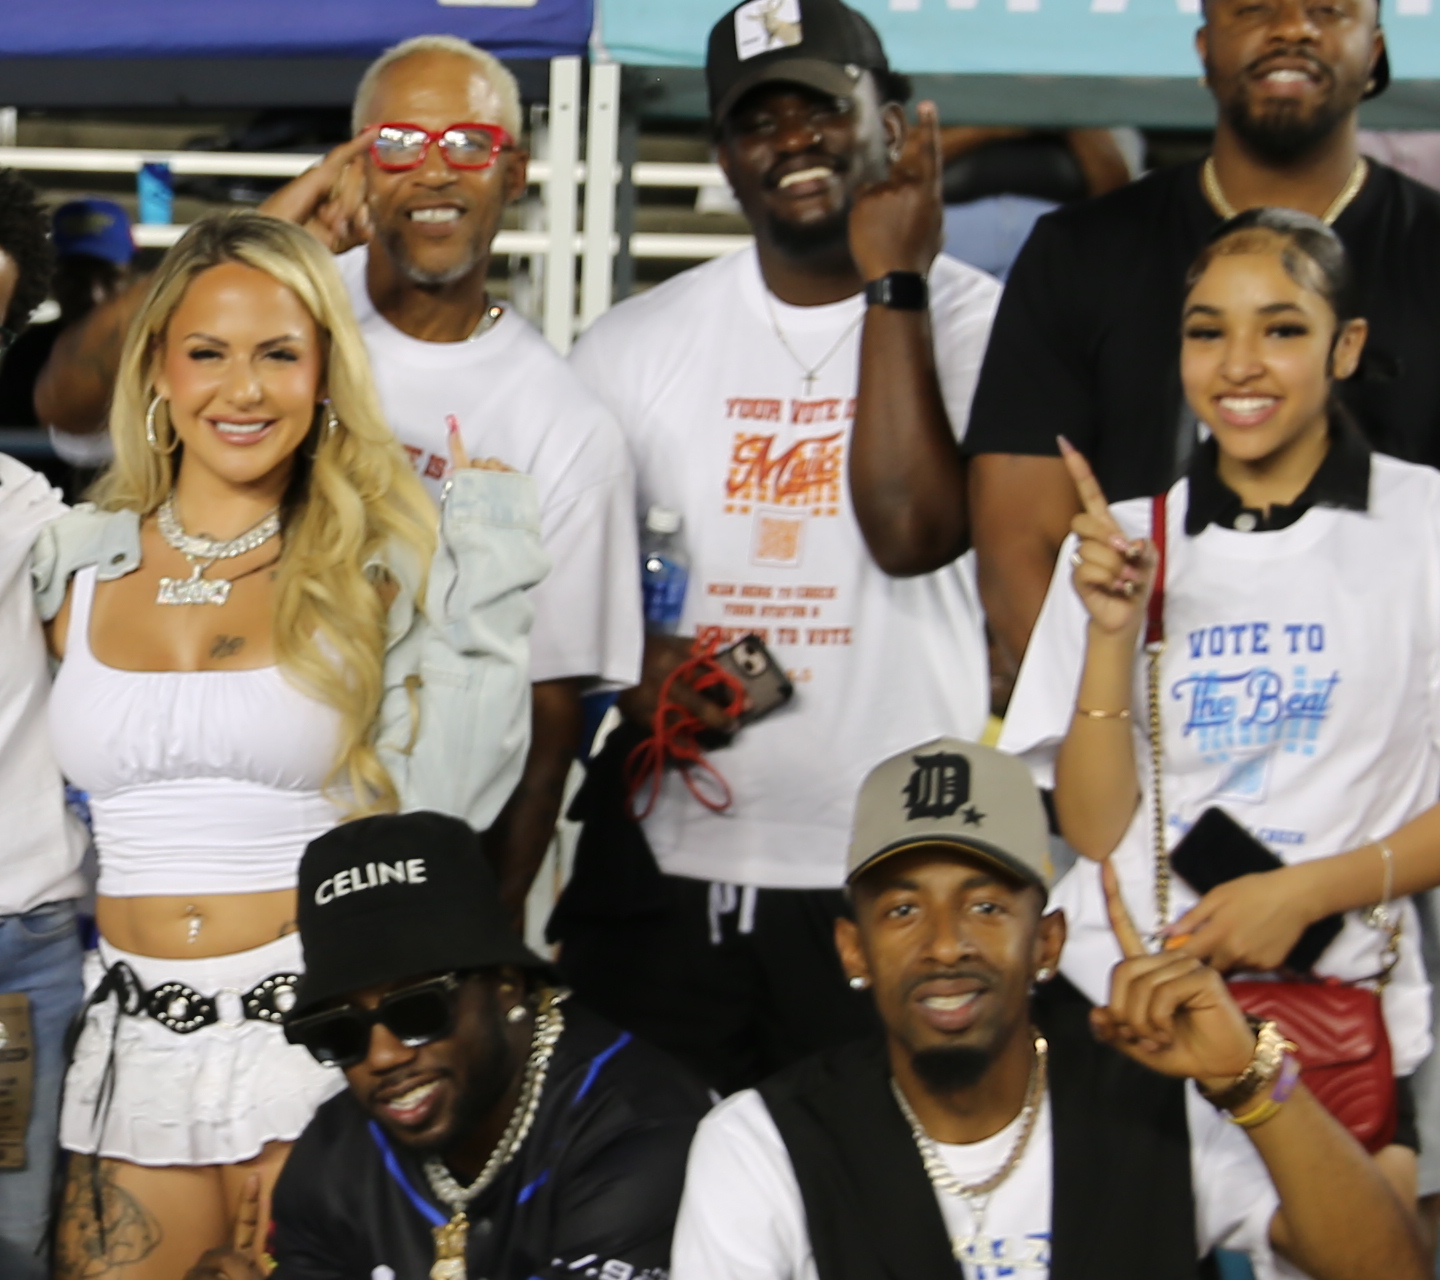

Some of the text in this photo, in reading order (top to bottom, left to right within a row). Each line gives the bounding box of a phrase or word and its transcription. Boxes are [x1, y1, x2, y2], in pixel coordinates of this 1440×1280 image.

[1187, 622, 1325, 659] VOTE TO
[1171, 668, 1342, 738] The Beat
[315, 858, 428, 907] CELINE
